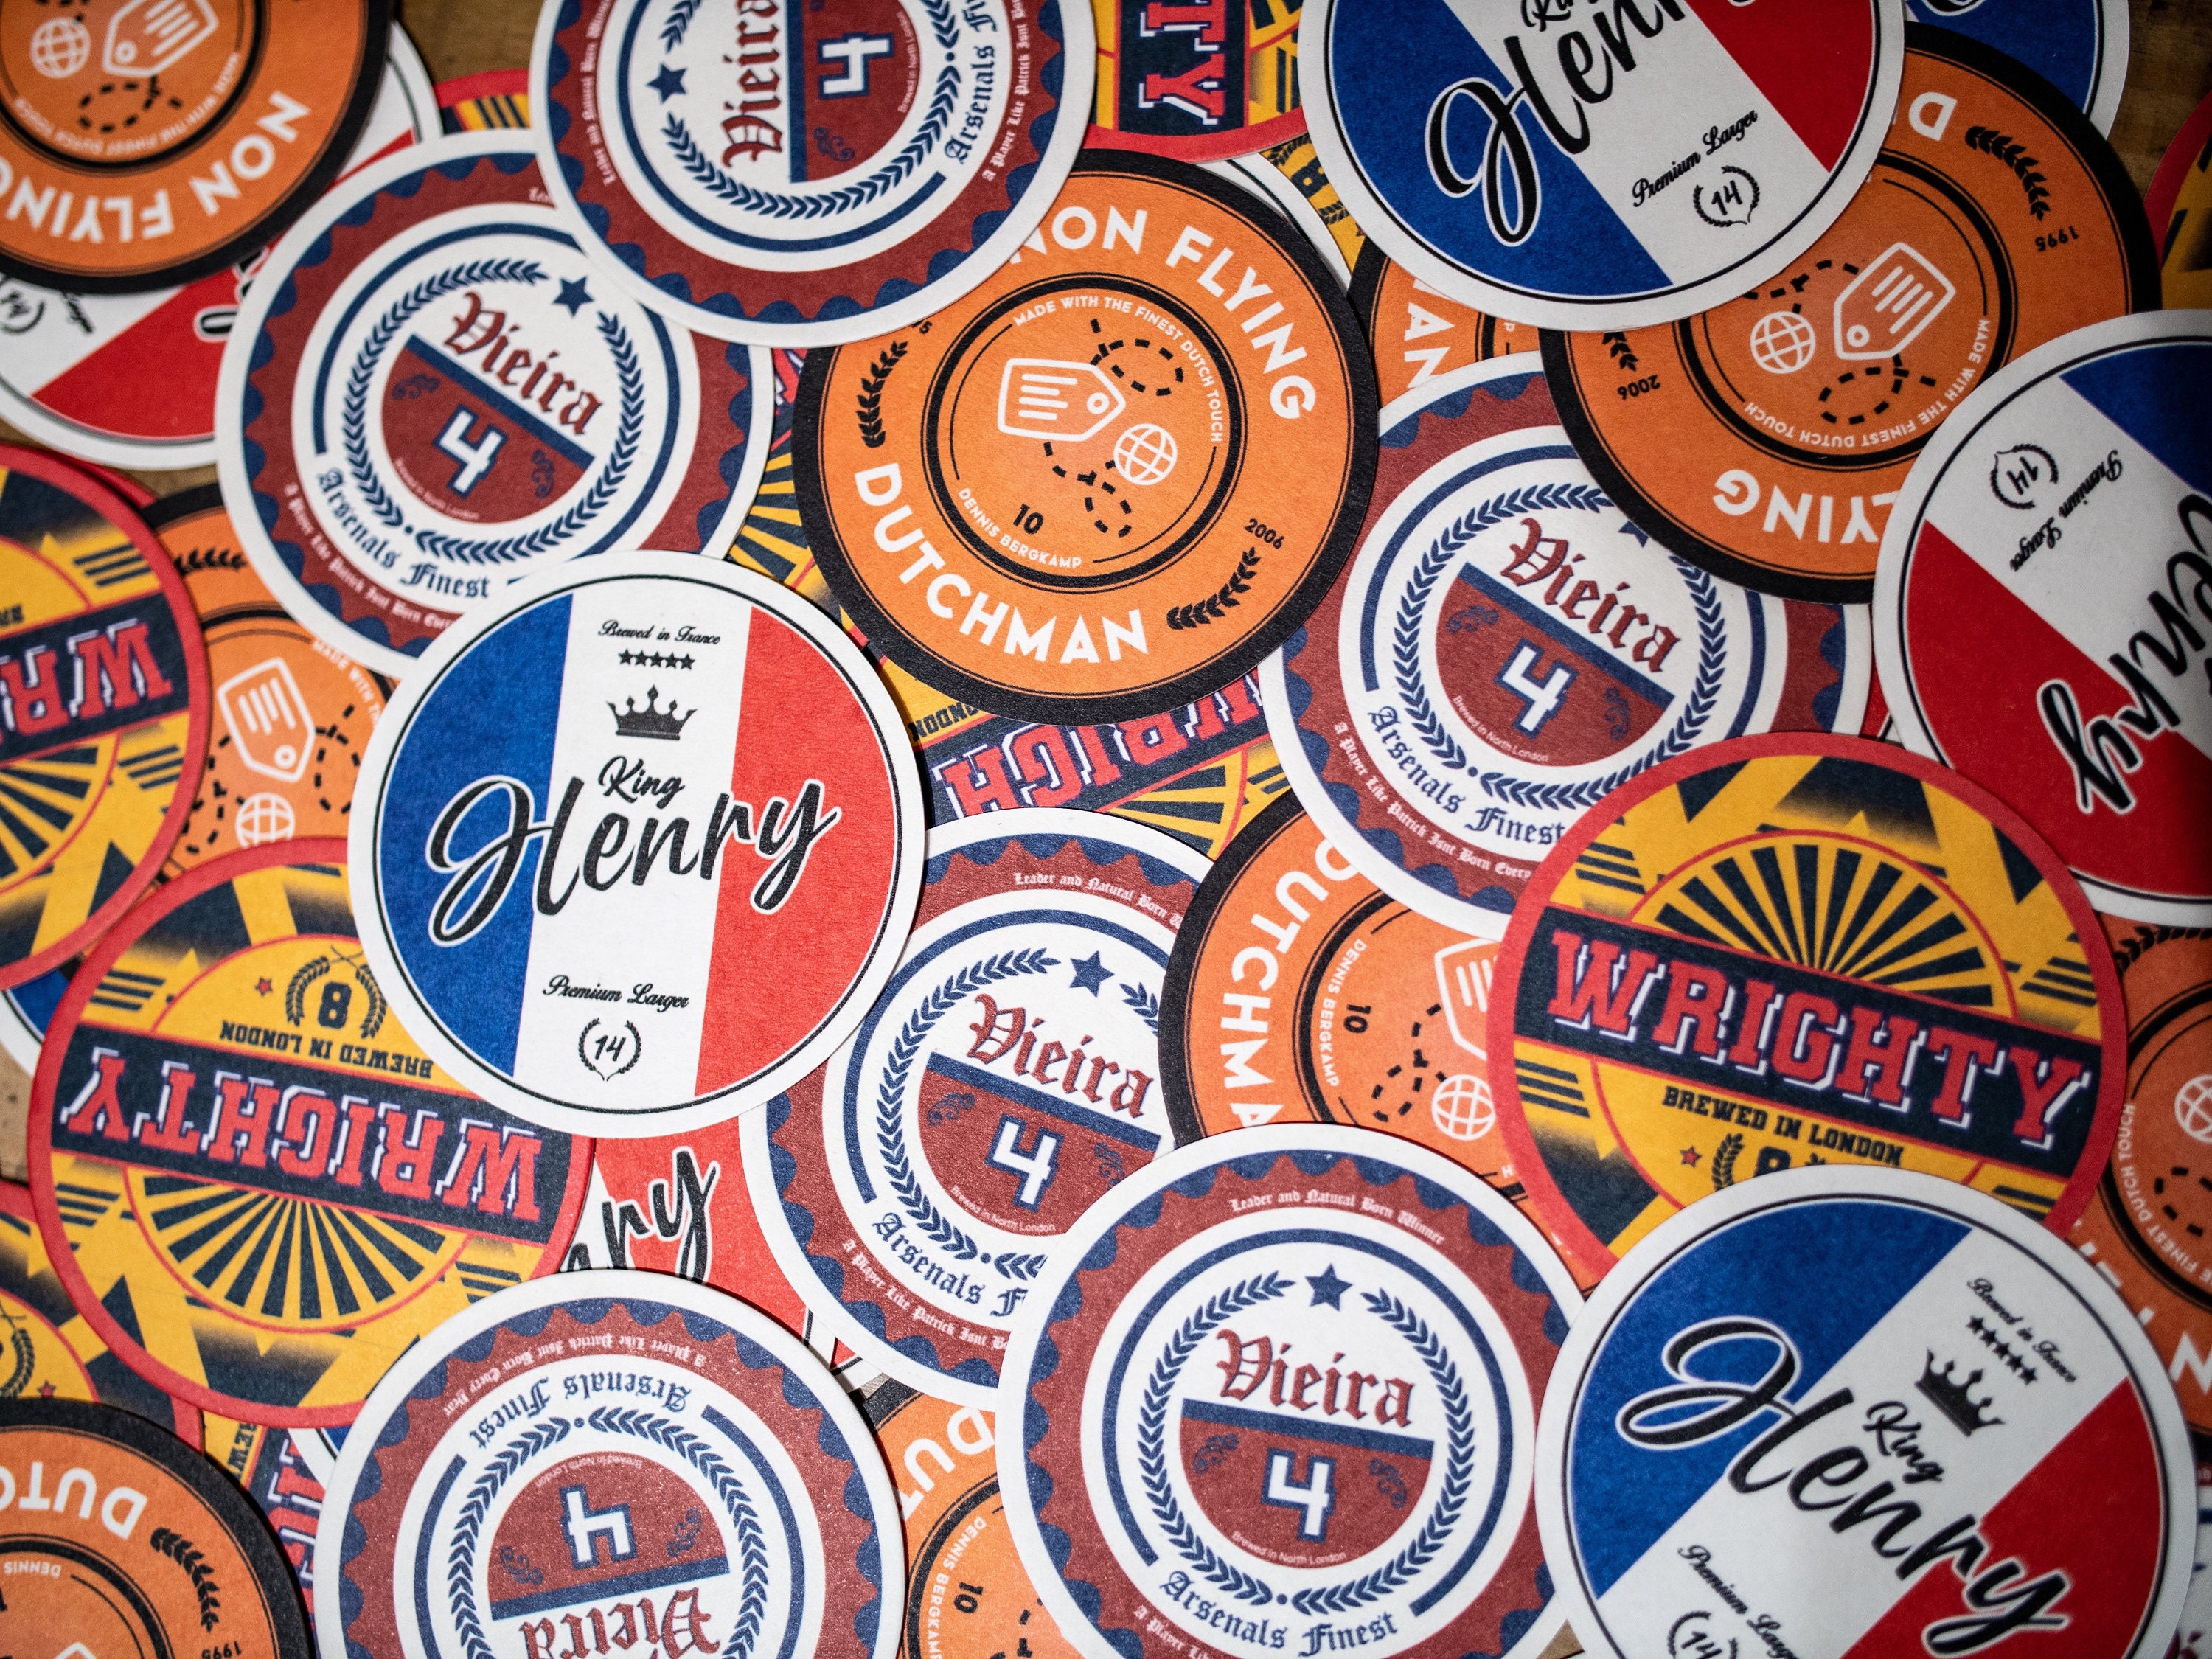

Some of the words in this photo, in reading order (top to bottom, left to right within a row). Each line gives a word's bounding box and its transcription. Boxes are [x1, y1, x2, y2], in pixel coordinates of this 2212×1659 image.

[818, 32, 894, 100] 4
[1427, 0, 1686, 246] Hen
[189, 91, 311, 217] NON
[1632, 151, 1702, 208] Premium
[1711, 180, 1743, 216] 14
[2034, 225, 2079, 252] 1995
[1165, 225, 1316, 419] FLYING
[1968, 319, 1992, 364] MADE
[444, 290, 604, 434] Vieira
[1012, 301, 1057, 327] MADE
[1060, 296, 1099, 310] WITH
[1104, 296, 1131, 313] THE
[1134, 305, 1185, 341] FINEST
[1180, 339, 1215, 389] DUTCH
[1206, 389, 1223, 442] TOUCH
[1617, 372, 1661, 401] 2006
[1944, 367, 1976, 403] WITH
[1744, 401, 1795, 439] TOUCH
[1860, 419, 1916, 448] FINEST
[1917, 400, 1947, 425] THE
[432, 403, 509, 500] 4
[1798, 430, 1856, 448] DUTCH
[2006, 456, 2038, 495] 14
[958, 487, 1000, 537] DENNIS
[999, 533, 1082, 568] BERGKAMP
[1013, 504, 1044, 535] 10
[1712, 469, 1901, 544] YING
[317, 467, 402, 569] Arsenals
[400, 562, 490, 598] Finest
[1243, 517, 1286, 550] 2006
[854, 462, 1150, 664] DUTCHMAN
[1500, 517, 1681, 673] Vieira
[598, 619, 655, 639] Brewed
[656, 627, 670, 641] in
[675, 625, 721, 645] France
[1494, 636, 1580, 740] 4
[1334, 722, 1348, 735] A
[1339, 735, 1368, 776] Player
[1368, 705, 1466, 813] Arsenals
[1464, 806, 1565, 845] Finest
[598, 754, 686, 810] King
[1366, 775, 1388, 803] Like
[1386, 799, 1427, 838] Patrick
[1427, 832, 1455, 855] Isnt
[428, 776, 840, 945] Henry
[1458, 849, 1492, 871] Born
[1014, 872, 1055, 885] Leader
[1060, 874, 1082, 887] and
[1085, 877, 1134, 902] Natural
[1136, 893, 1167, 919] Born
[543, 975, 622, 1002] Premium
[1220, 838, 1360, 1128] DUTCHMA
[1327, 938, 1367, 995] DENNIS
[317, 981, 352, 1029] 8
[1343, 1004, 1371, 1034] 10
[219, 1020, 303, 1054] LONDON
[309, 1037, 333, 1060] IN
[339, 1043, 434, 1079] BREWED
[595, 1034, 627, 1062] 14
[965, 993, 1155, 1119] Vieira
[1318, 998, 1340, 1088] BERGKAMP
[1548, 930, 2092, 1150] WRIGHTY
[60, 1046, 543, 1221] WRIGHTY
[1661, 1085, 1768, 1132] BREWED
[1773, 1114, 1802, 1140] IN
[1807, 1123, 1905, 1166] LONDON
[2117, 1103, 2136, 1161] TOUCH
[984, 1114, 1066, 1213] 4
[950, 1185, 981, 1214] Brewed
[991, 1214, 1018, 1228] North
[1019, 1222, 1056, 1232] London
[1229, 1192, 1273, 1212] Leader
[1278, 1189, 1301, 1203] and
[1304, 1189, 1355, 1208] Natural
[1361, 1196, 1394, 1218] Born
[1397, 1209, 1445, 1245] Winner
[2121, 1165, 2153, 1222] DUTCH
[872, 1212, 986, 1305] Arsenals
[2146, 1224, 2199, 1274] FINEST
[842, 1239, 856, 1253] A
[851, 1253, 886, 1288] Player
[885, 1285, 911, 1310] Like
[912, 1305, 956, 1337] Patrick
[959, 1327, 987, 1347] Isnt
[502, 1351, 535, 1371] Born
[537, 1341, 566, 1358] Isnt
[568, 1332, 613, 1351] Patrick
[618, 1335, 645, 1351] Like
[651, 1338, 691, 1361] Player
[469, 1367, 501, 1394] Every
[562, 1371, 692, 1413] Arsenals
[1216, 1329, 1419, 1429] Vieira
[469, 1377, 551, 1450] Finest
[1862, 1401, 1944, 1484] King
[1260, 1447, 1337, 1543] 4
[1617, 1316, 2070, 1656] Henry
[559, 1483, 639, 1571] 4
[943, 1517, 987, 1571] DENNIS
[1231, 1531, 1267, 1556] Brewed
[1279, 1551, 1307, 1564] North
[1309, 1551, 1347, 1565] London
[4, 1559, 62, 1579] DENNIS
[1677, 1545, 1748, 1614] Premium
[953, 1581, 984, 1615] 10
[1159, 1571, 1287, 1649] Arsenals
[1298, 1611, 1398, 1658] Finest
[1133, 1604, 1149, 1620] A
[1147, 1617, 1186, 1651] Player
